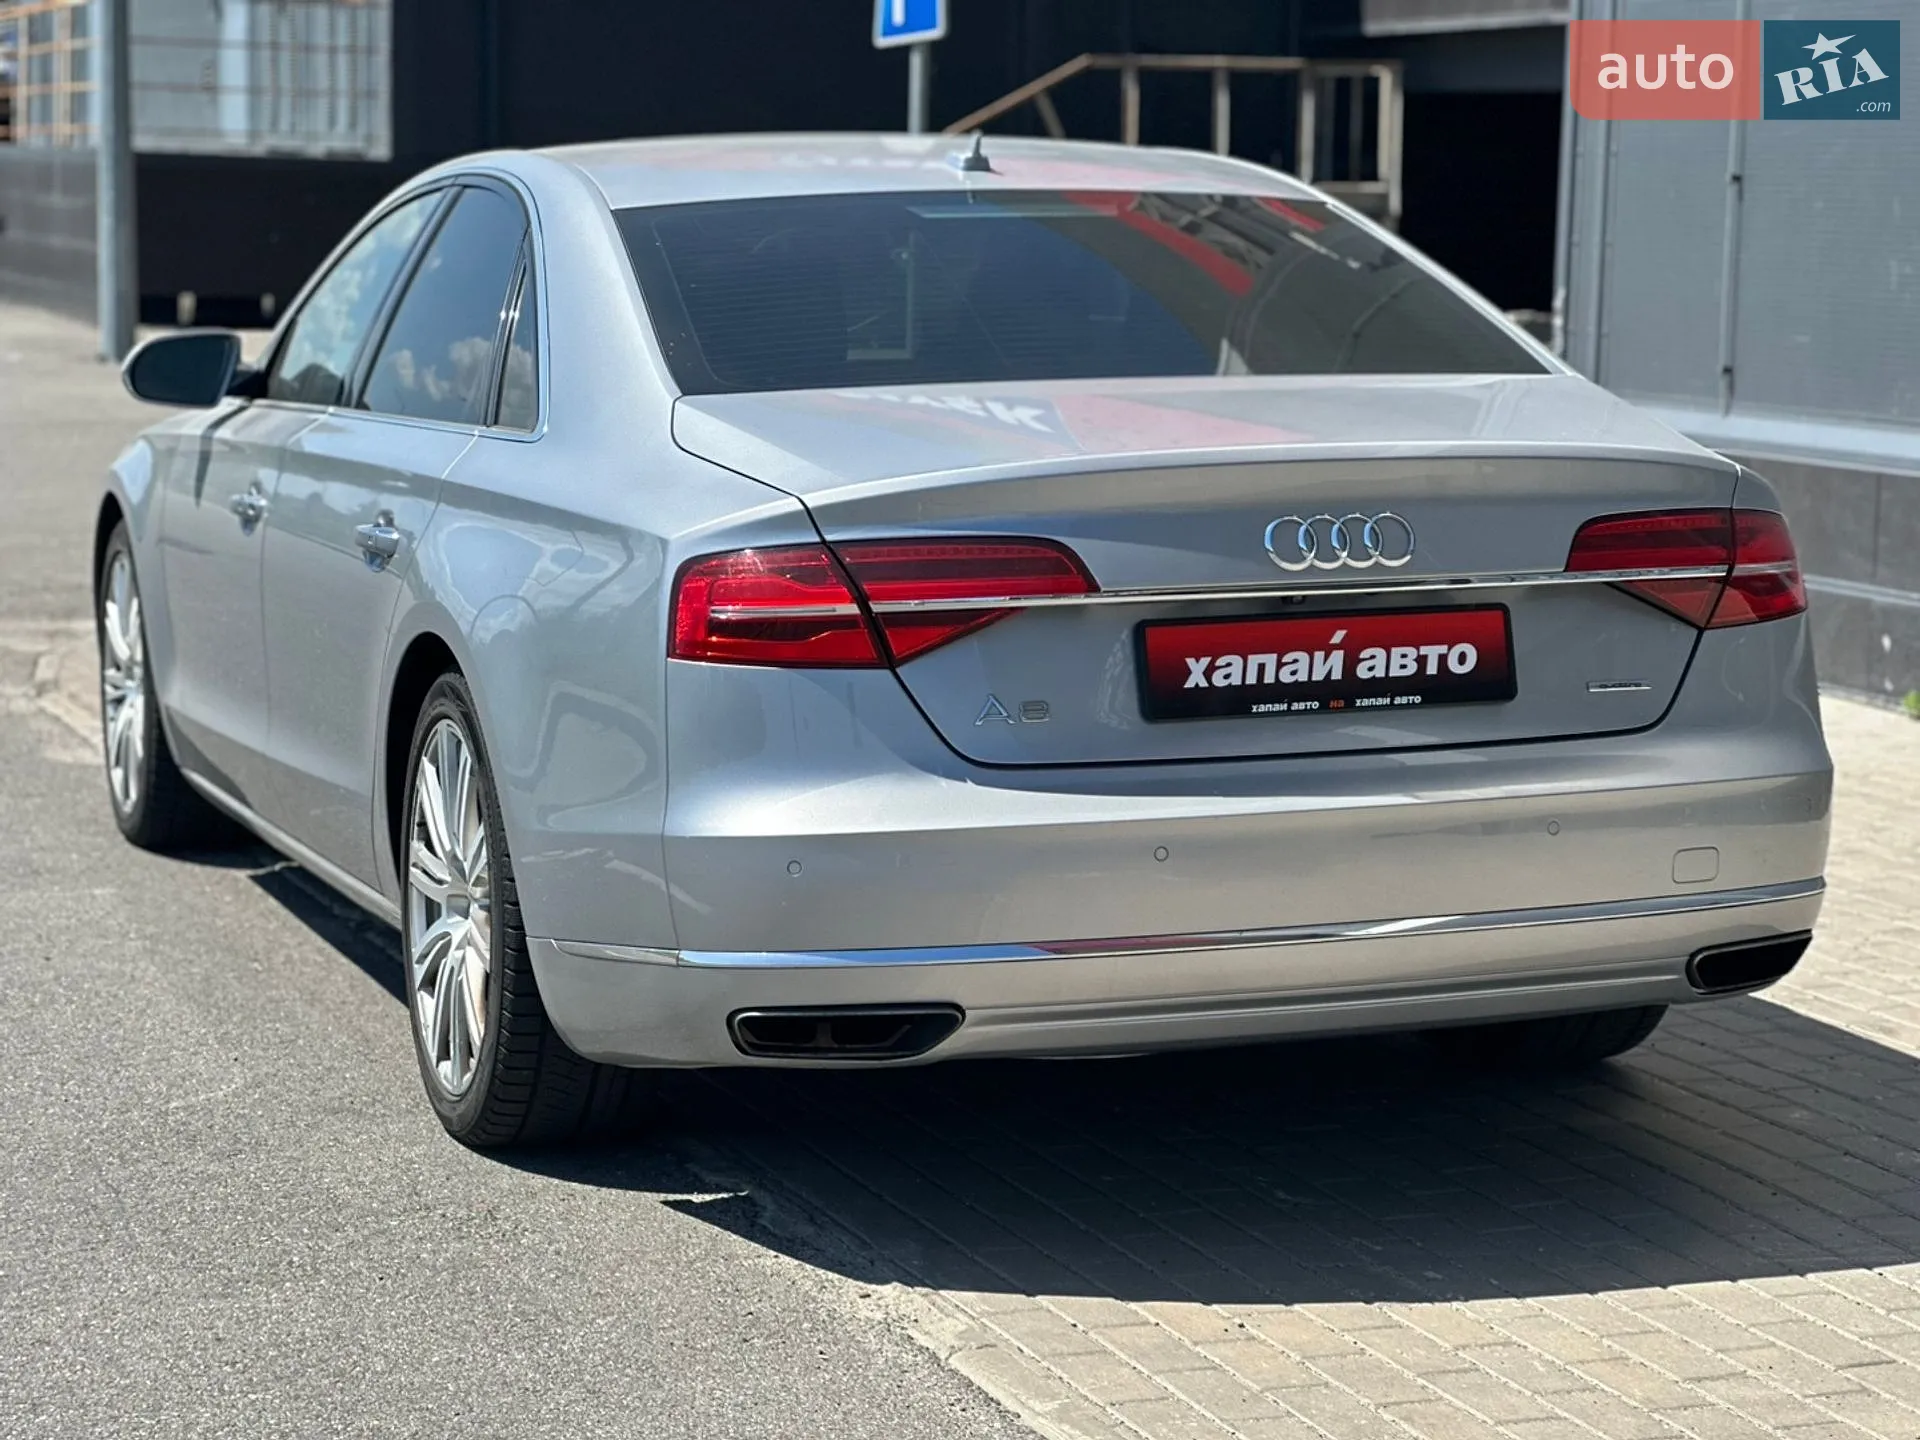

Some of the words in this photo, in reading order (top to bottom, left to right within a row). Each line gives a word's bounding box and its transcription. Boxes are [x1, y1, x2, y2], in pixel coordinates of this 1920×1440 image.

[1183, 630, 1348, 688] хапай
[1356, 642, 1478, 680] авто
[974, 694, 1049, 725] A8
[1290, 701, 1319, 710] авто
[1393, 694, 1421, 705] авто
